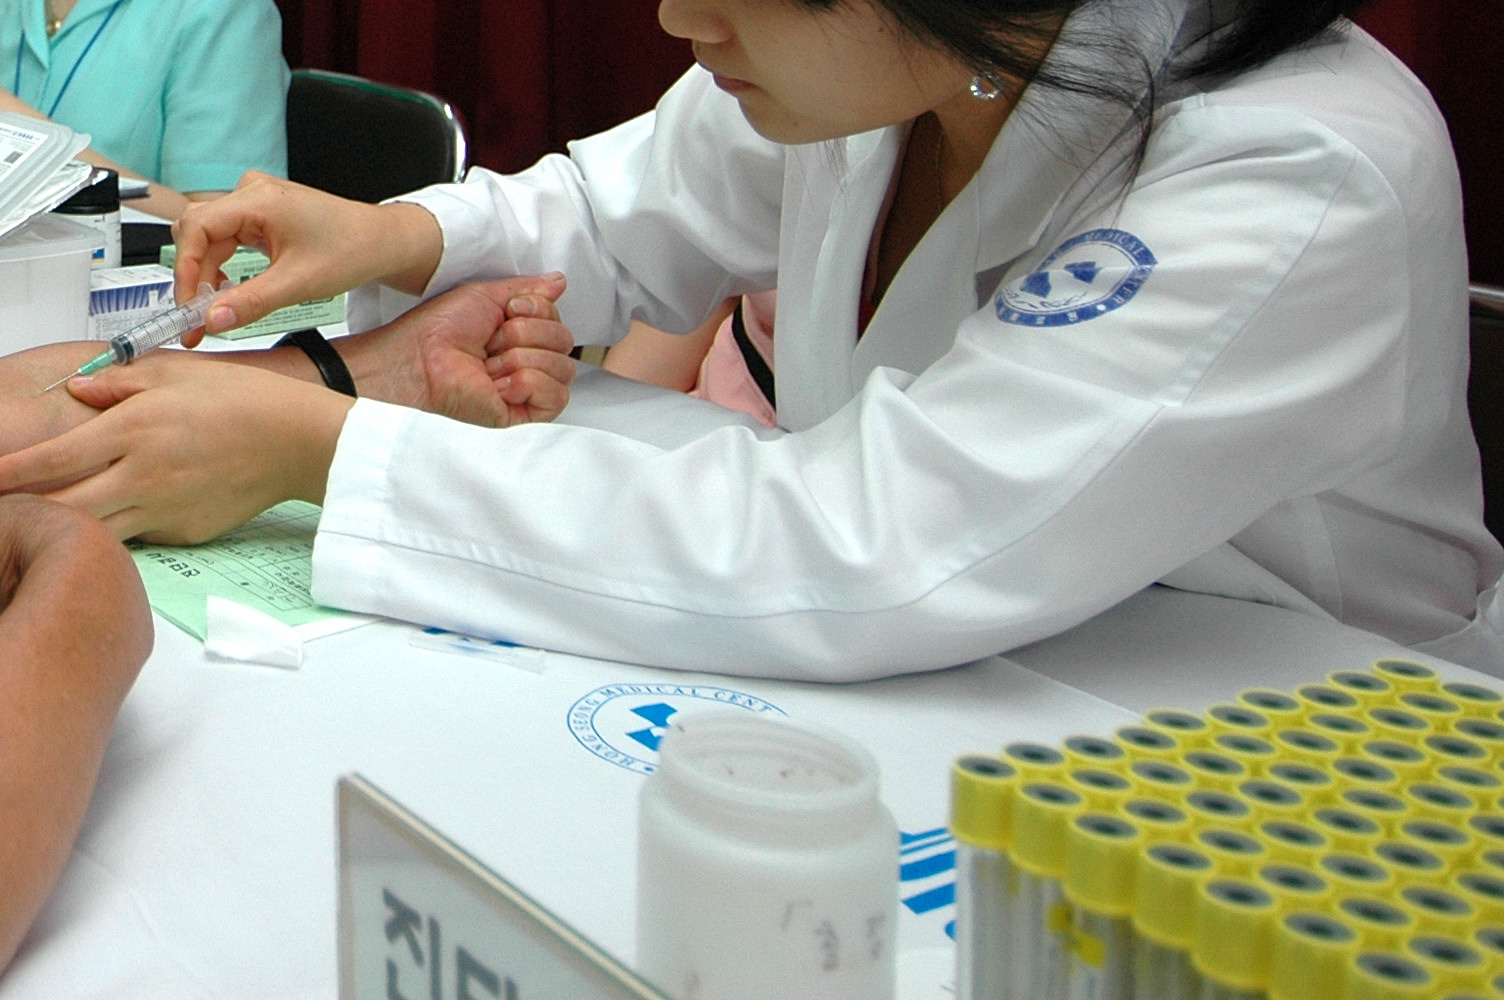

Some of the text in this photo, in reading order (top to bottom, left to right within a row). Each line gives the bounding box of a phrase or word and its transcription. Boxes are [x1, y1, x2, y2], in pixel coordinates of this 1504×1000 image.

[574, 685, 773, 766] HONG SEONG MEDICAL CENT
